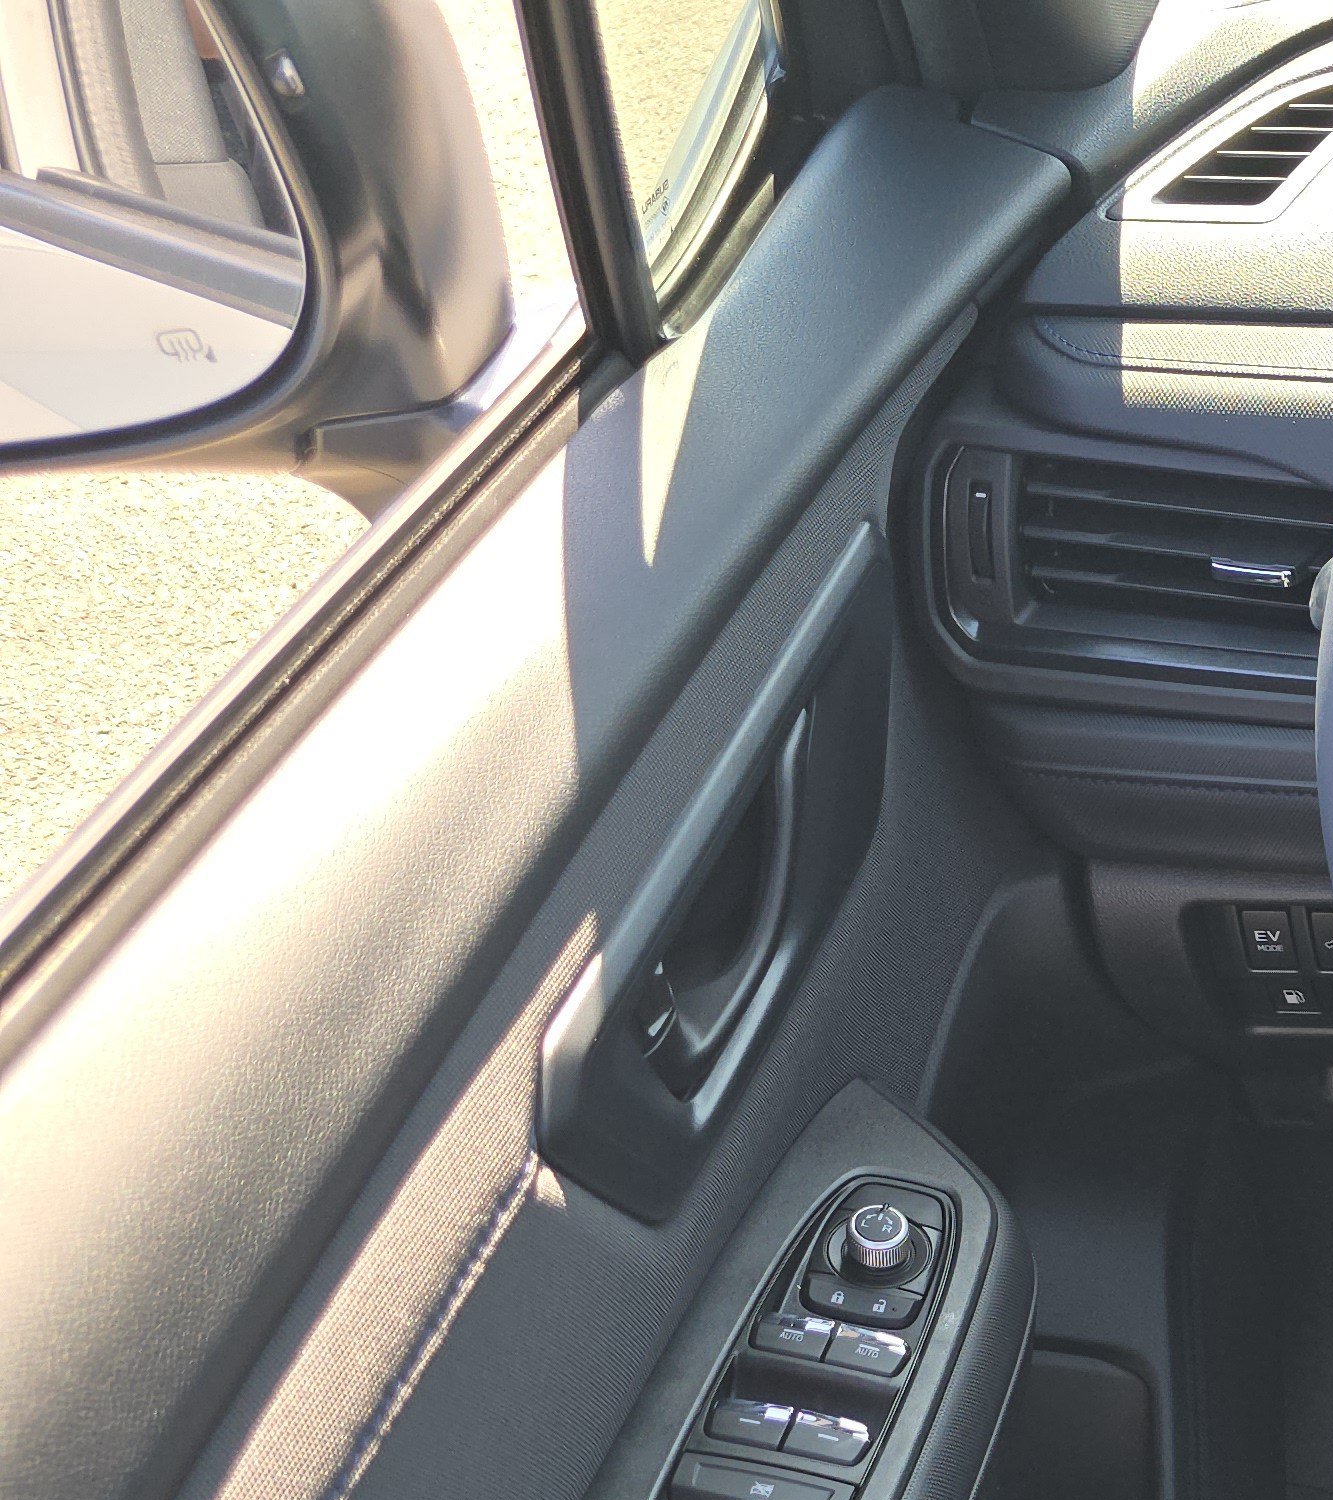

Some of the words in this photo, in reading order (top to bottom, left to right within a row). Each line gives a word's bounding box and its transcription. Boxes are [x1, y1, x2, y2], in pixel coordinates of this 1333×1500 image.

[1254, 930, 1281, 943] EV
[1257, 944, 1284, 953] MODE
[779, 1330, 805, 1343] AUTO
[854, 1345, 880, 1359] AUTO
